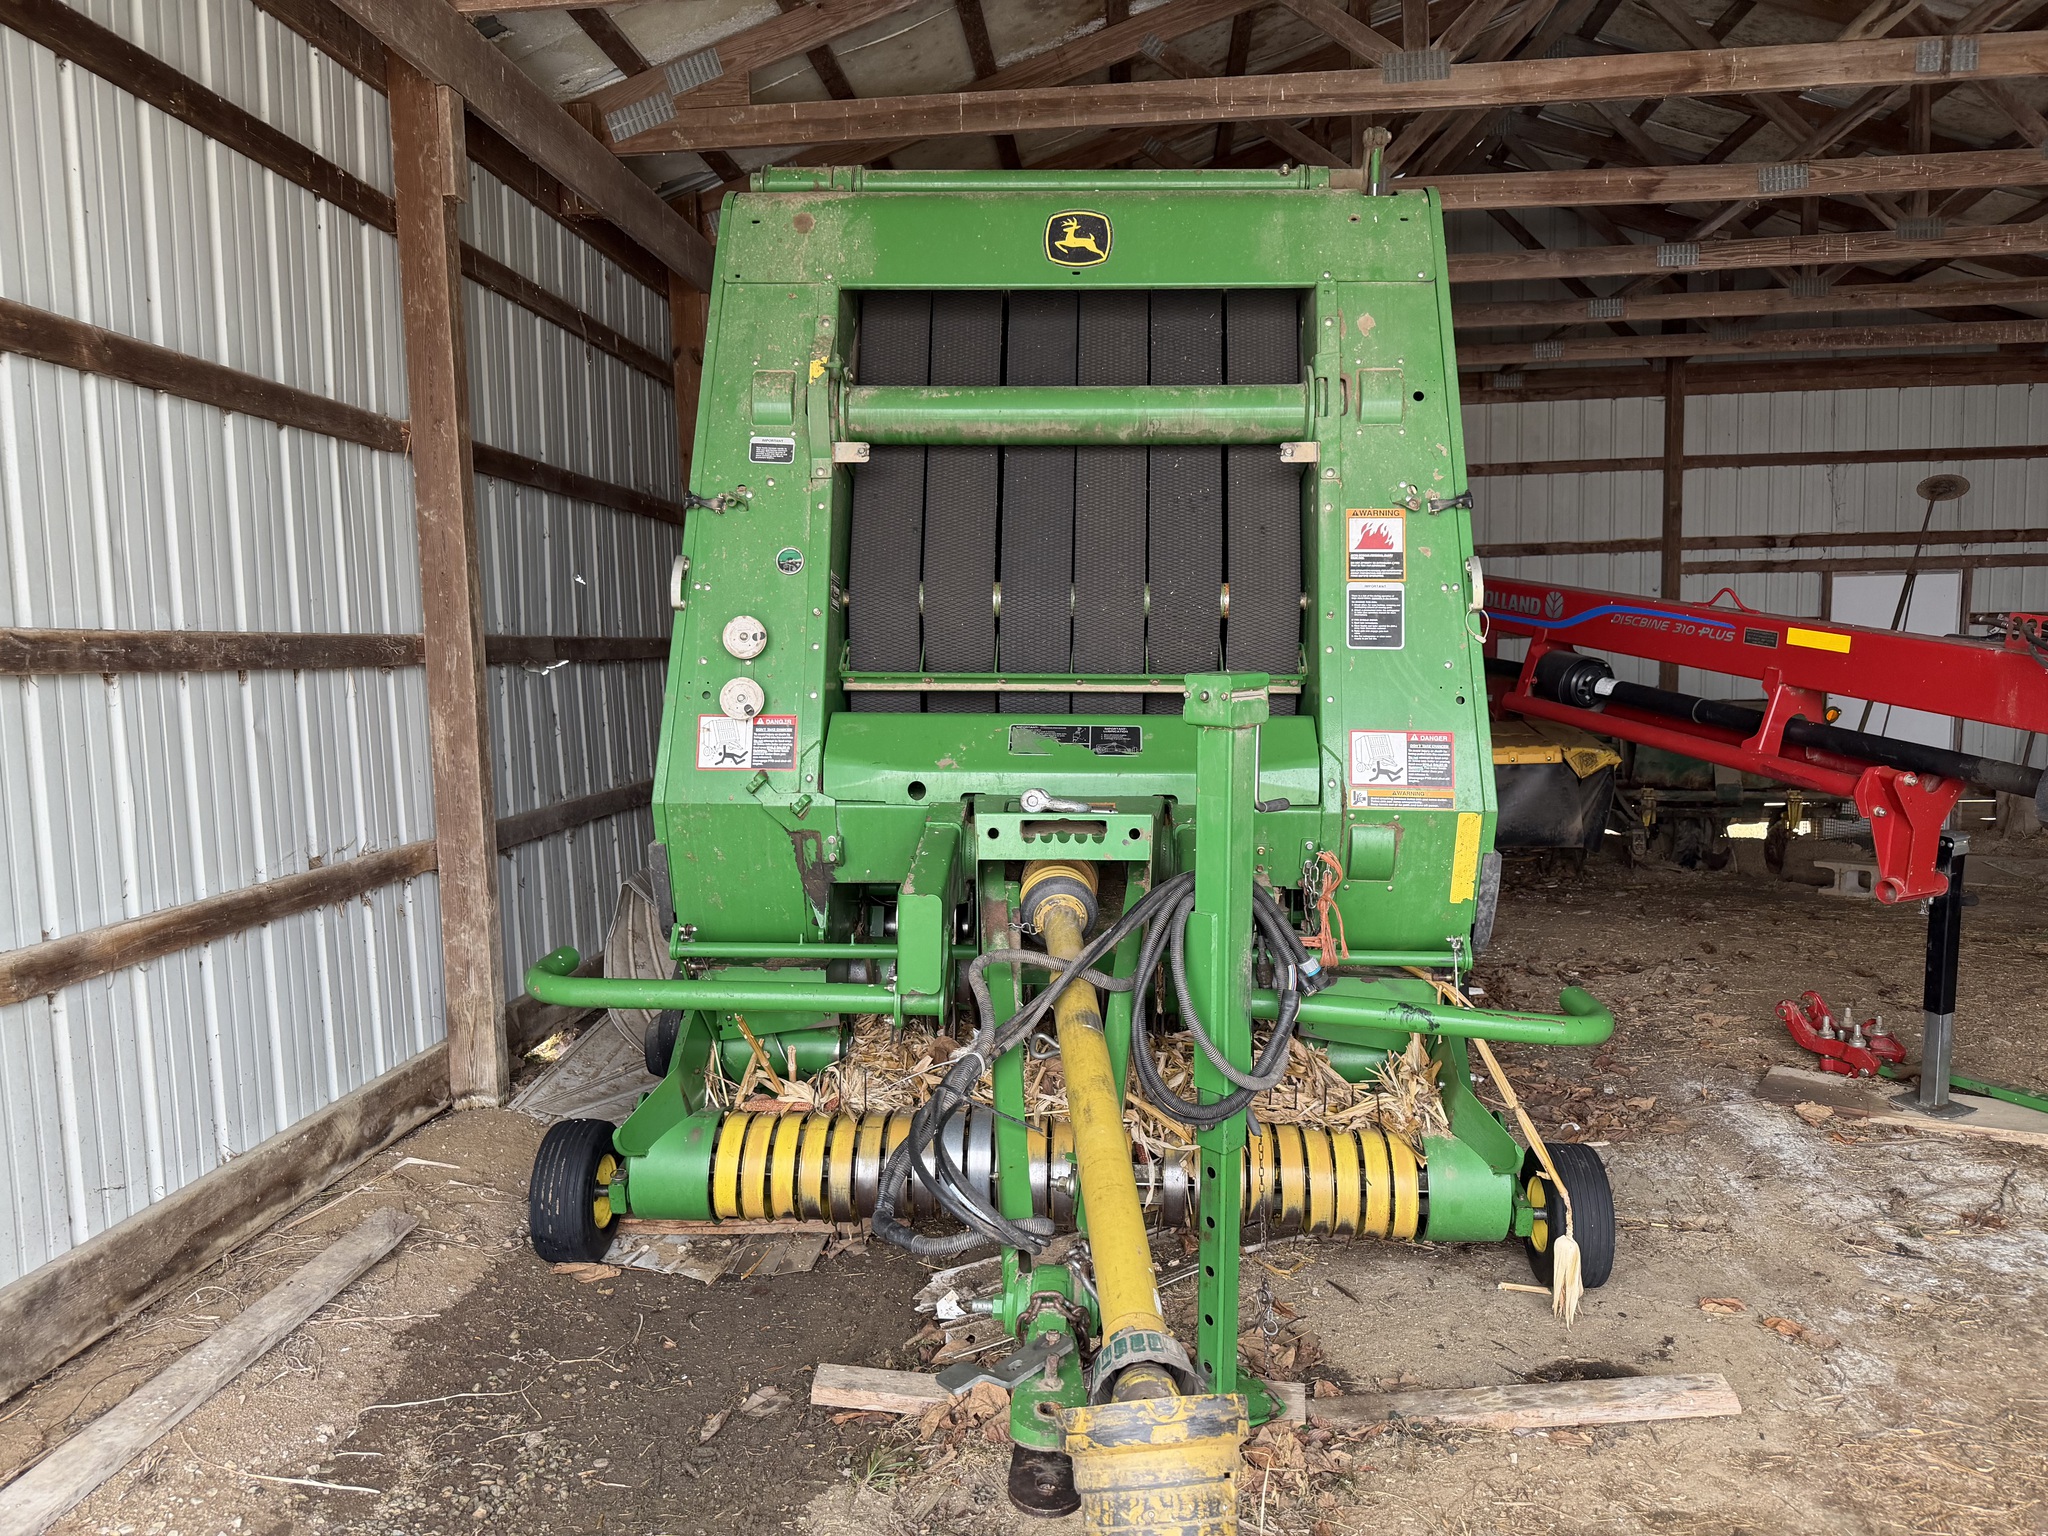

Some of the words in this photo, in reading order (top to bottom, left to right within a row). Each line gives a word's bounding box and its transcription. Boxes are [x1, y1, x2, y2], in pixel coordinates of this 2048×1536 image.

[1359, 509, 1400, 517] WARNING
[1484, 590, 1541, 616] OLLAND
[1611, 613, 1671, 631] DISCBINE
[1672, 622, 1696, 635] 310
